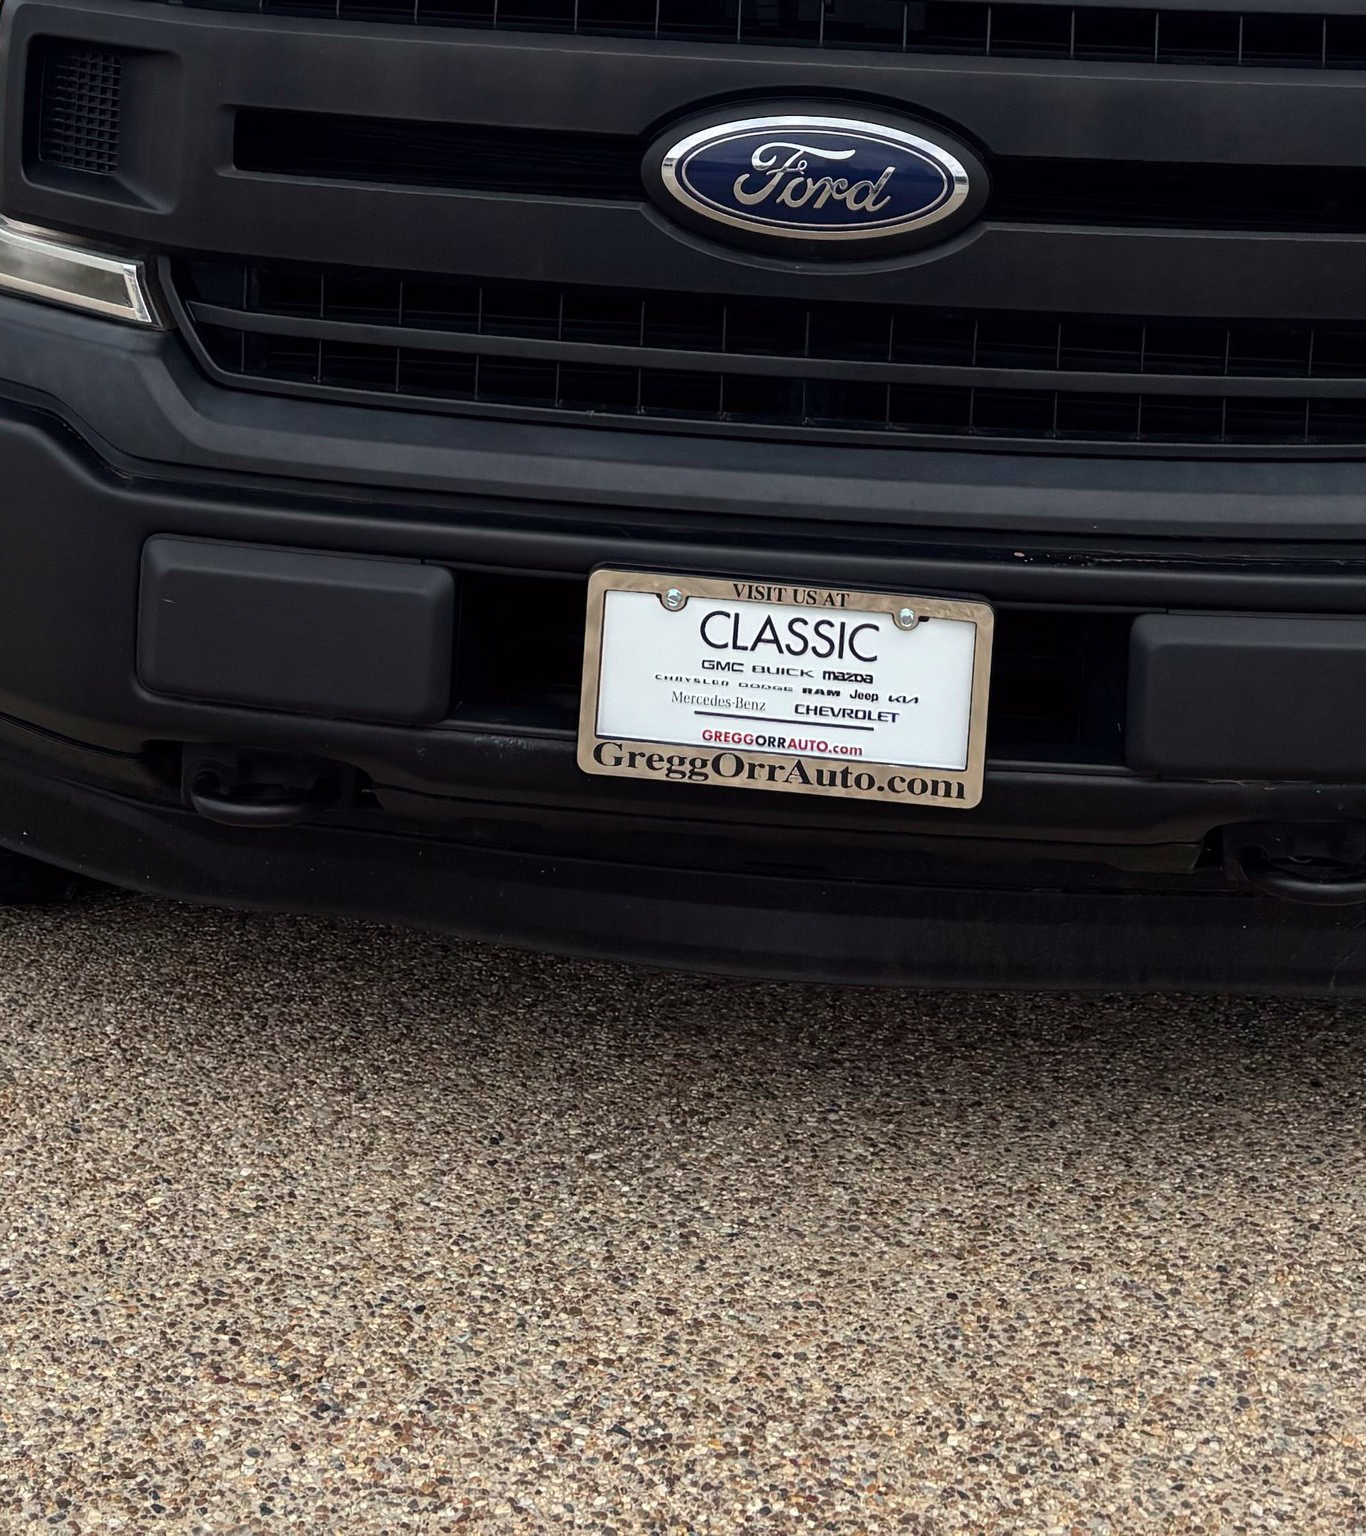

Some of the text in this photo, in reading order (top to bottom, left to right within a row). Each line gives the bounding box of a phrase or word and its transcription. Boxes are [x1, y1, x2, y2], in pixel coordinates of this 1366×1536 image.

[734, 141, 895, 212] Ford
[733, 583, 850, 608] VISIT US AT
[700, 610, 880, 663] CLASSIC
[701, 659, 744, 673] GMC
[752, 665, 815, 679] BUICK
[655, 673, 730, 687] CHRYSLER
[738, 682, 793, 692] DODGE
[802, 687, 841, 697] RAM
[849, 689, 879, 703] Jeep
[671, 690, 900, 723] Mercedes-Benz CHEVROLET
[702, 729, 863, 756] GREGGORRAUTO.com
[592, 741, 966, 801] GreggOrrAuto.com
